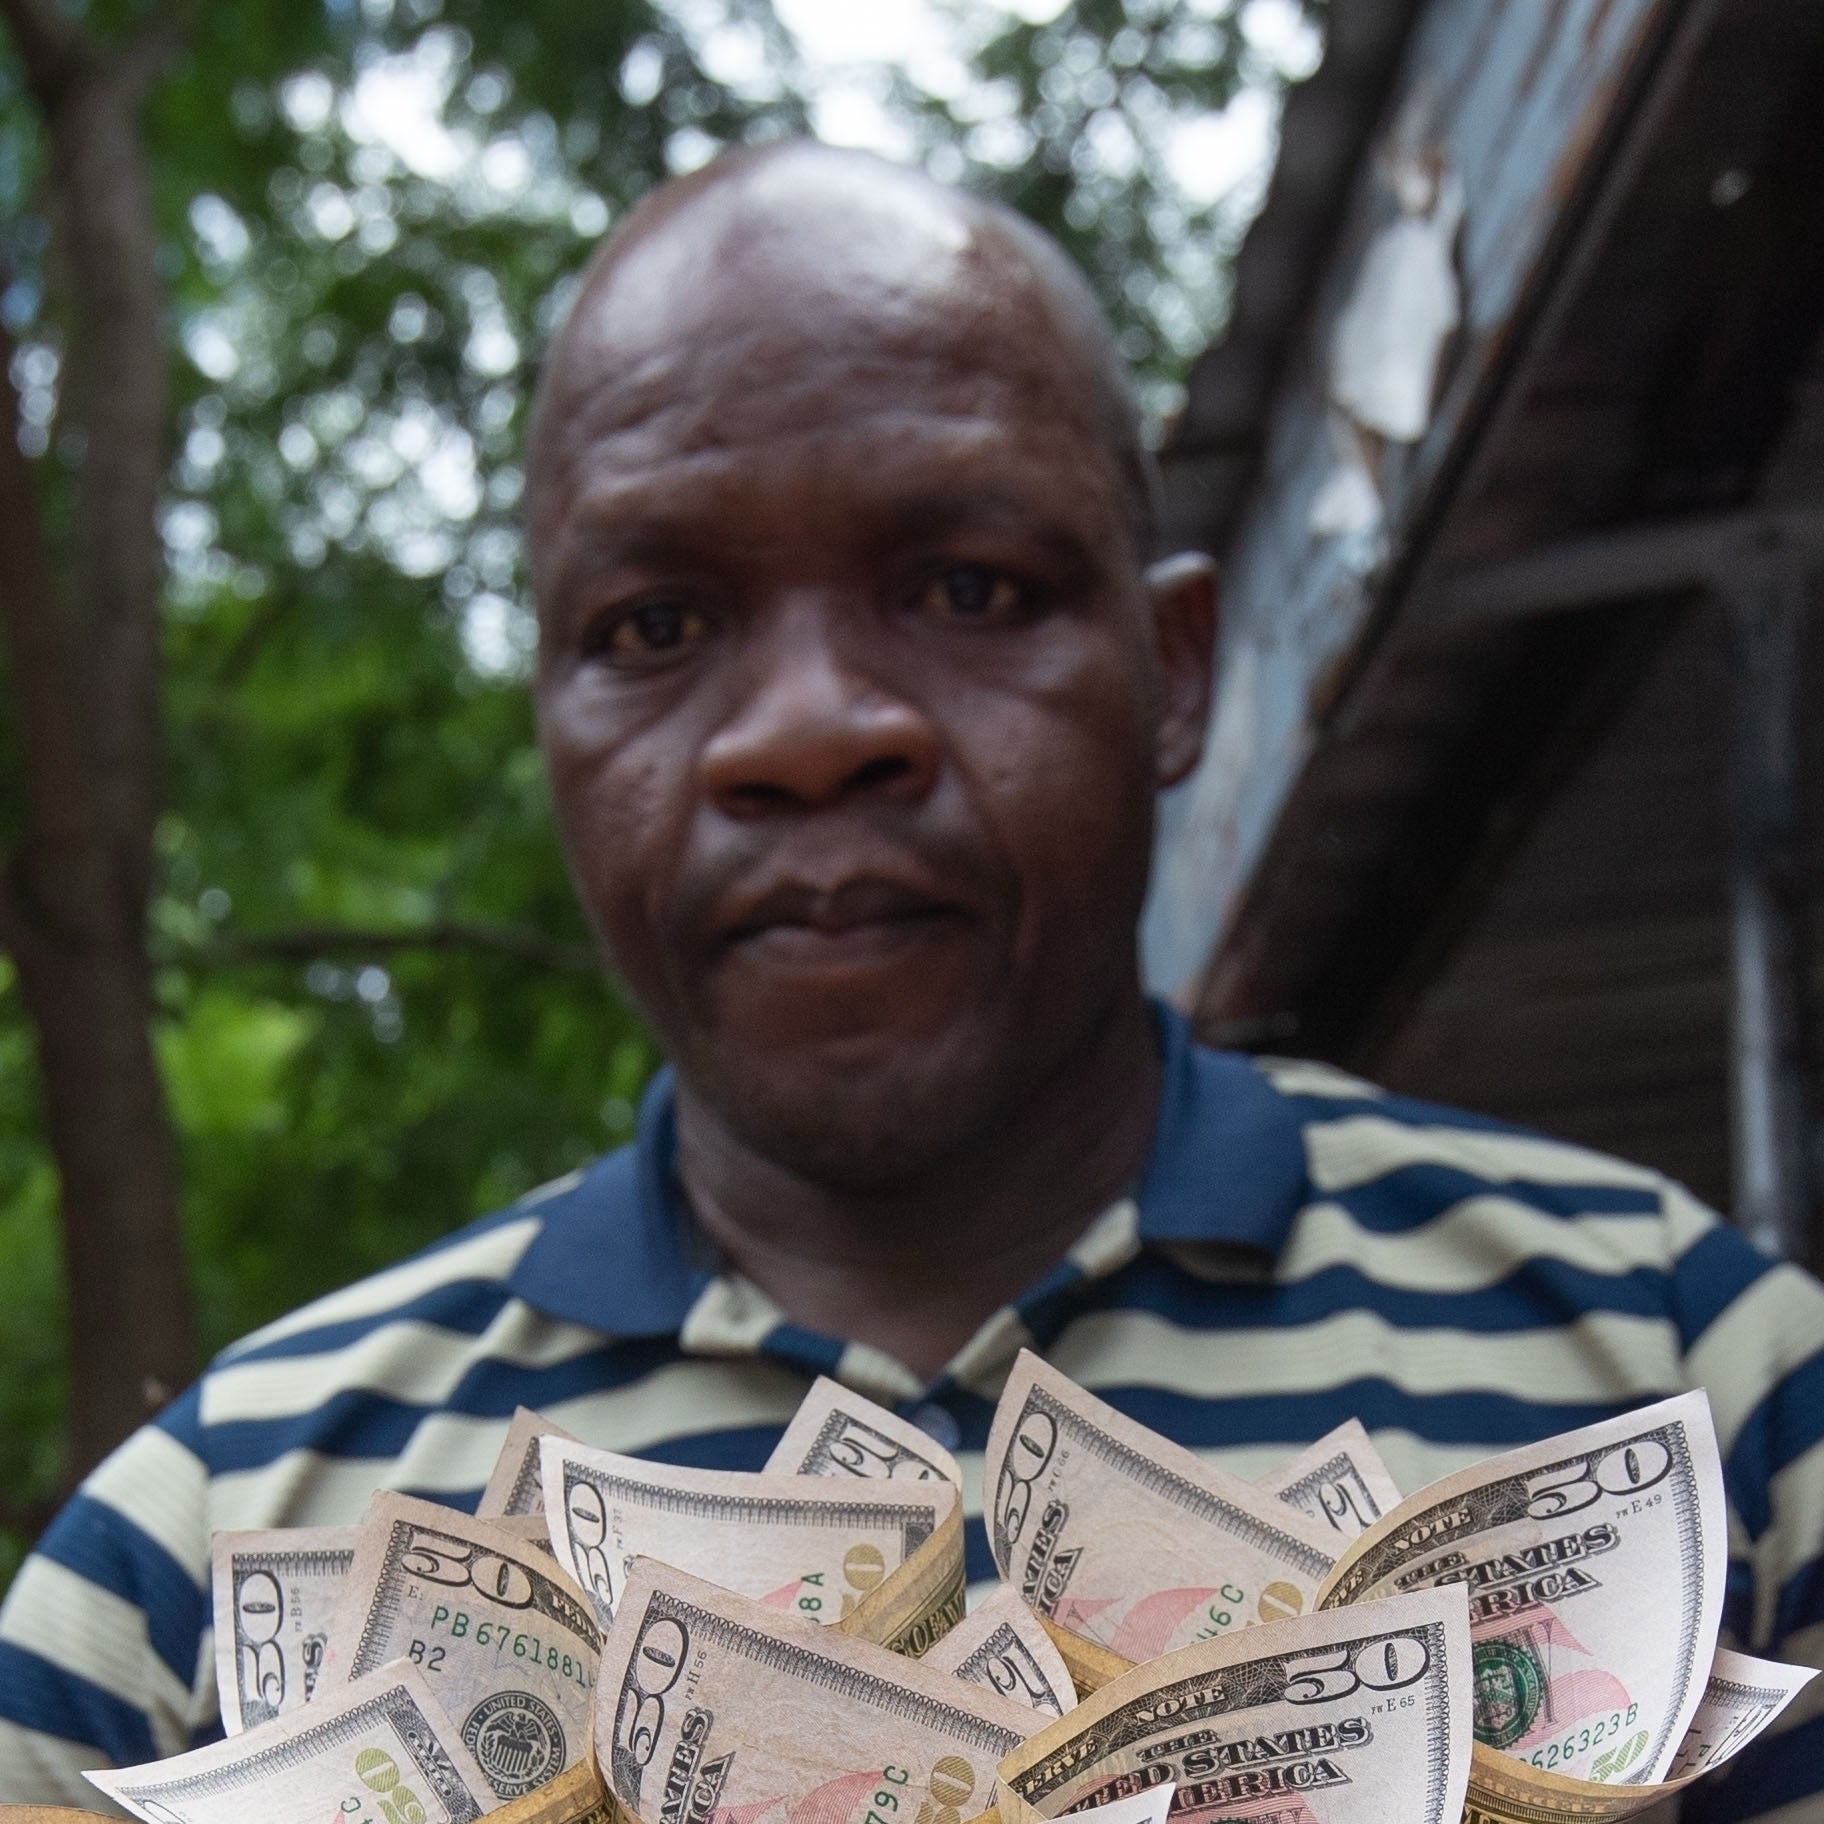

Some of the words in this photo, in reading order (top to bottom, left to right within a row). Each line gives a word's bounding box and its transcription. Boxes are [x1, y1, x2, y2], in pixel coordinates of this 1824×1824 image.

[1002, 1412, 1057, 1543] 50
[1395, 1509, 1473, 1551] NOTE
[1527, 1439, 1677, 1521] 50
[1644, 1494, 1663, 1508] 49
[401, 1527, 534, 1609] 50
[572, 1481, 614, 1607] 50
[1394, 1552, 1468, 1590] THE
[239, 1570, 285, 1707] 50
[408, 1640, 446, 1672] B2
[484, 1697, 526, 1716] UNITED
[528, 1701, 558, 1736] STATES
[632, 1618, 690, 1765] 50
[1134, 1686, 1226, 1725] NOTE
[1283, 1637, 1432, 1706] 50
[1398, 1695, 1416, 1708] 65
[1136, 1728, 1222, 1762] THE
[1179, 1716, 1374, 1778] STATES
